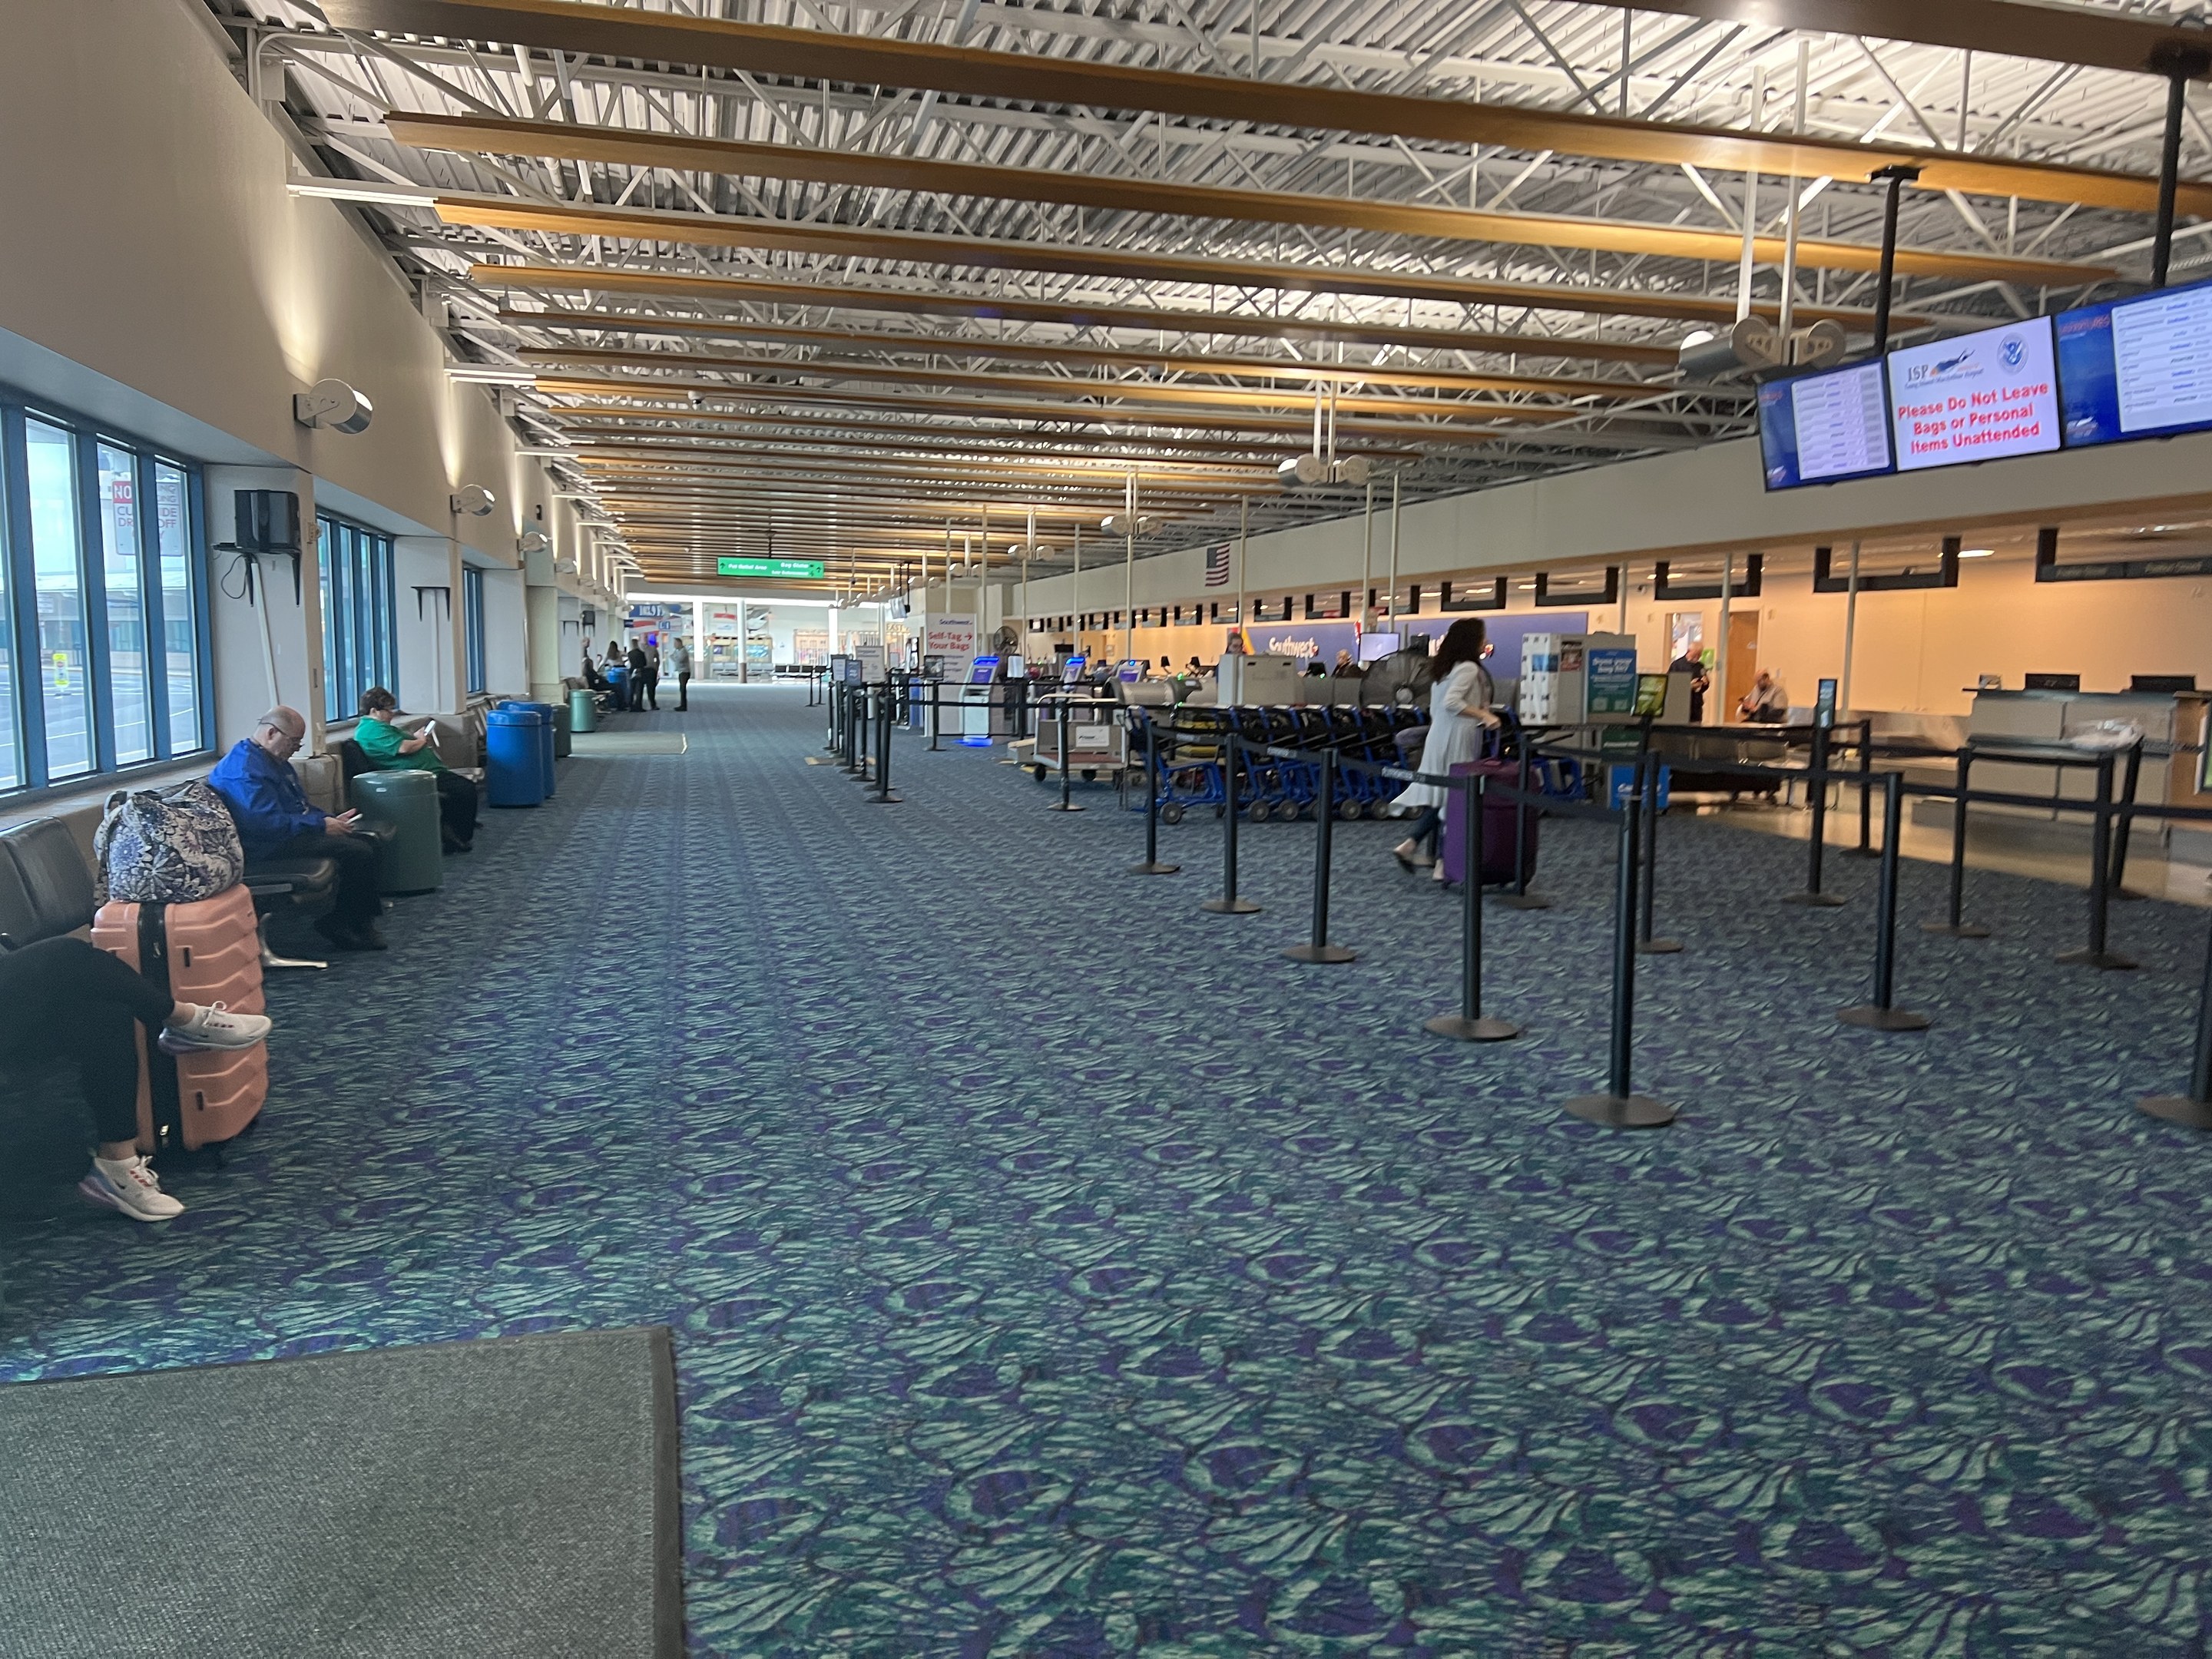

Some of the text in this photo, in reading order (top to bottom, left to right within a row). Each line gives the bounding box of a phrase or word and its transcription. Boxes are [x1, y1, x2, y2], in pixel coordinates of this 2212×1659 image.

[1908, 364, 1929, 381] ISP
[1898, 382, 2049, 421] Please Do Not Leave
[1913, 403, 2034, 436] Bags or Personal
[1911, 422, 2041, 455] Items Unattended
[114, 485, 132, 499] NO
[929, 631, 962, 642] Self-Tag
[949, 642, 970, 651] Bags
[1269, 636, 1314, 658] Southwest
